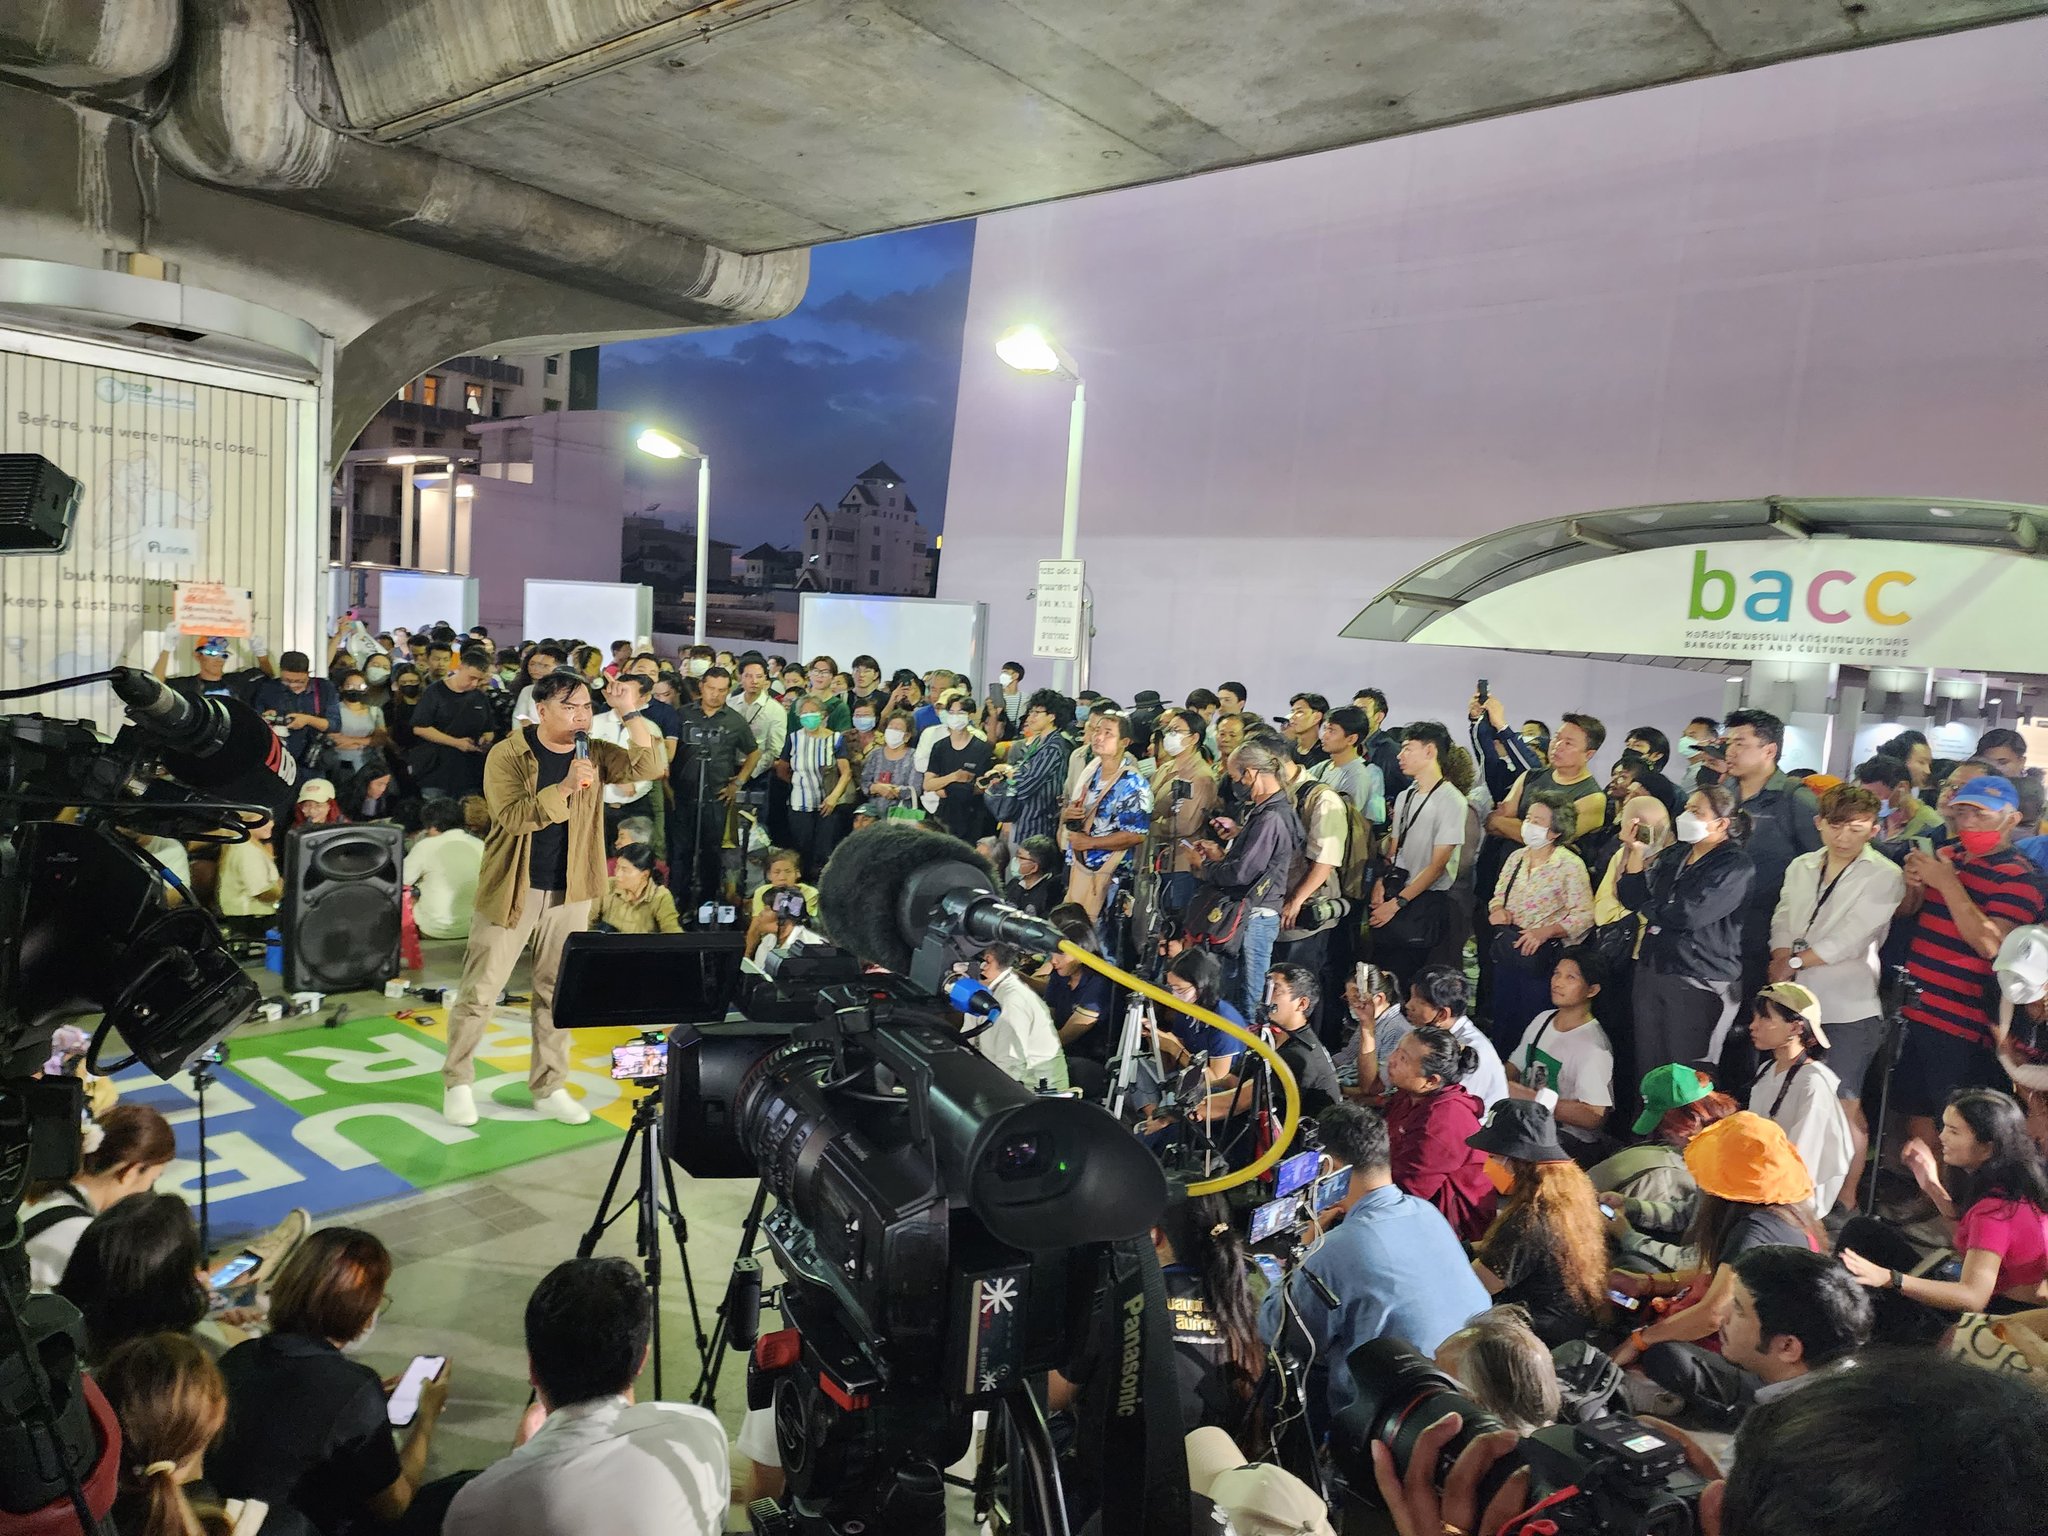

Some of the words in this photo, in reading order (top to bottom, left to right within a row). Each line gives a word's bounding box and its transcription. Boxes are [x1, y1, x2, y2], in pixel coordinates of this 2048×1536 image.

[17, 411, 84, 434] Before,
[89, 424, 113, 436] we
[118, 428, 158, 442] were
[163, 433, 211, 449] much
[63, 566, 97, 582] but
[102, 573, 141, 585] now
[1688, 549, 1917, 626] bacc
[3, 592, 48, 613] keep
[72, 597, 151, 613] distance
[1684, 641, 1738, 650] BANGKOK
[1742, 643, 1764, 651] ART
[1768, 644, 1793, 652] AND
[1798, 644, 1854, 655] CULTURE
[1858, 647, 1910, 658] CENTRE
[1117, 1292, 1145, 1417] Panasonic
